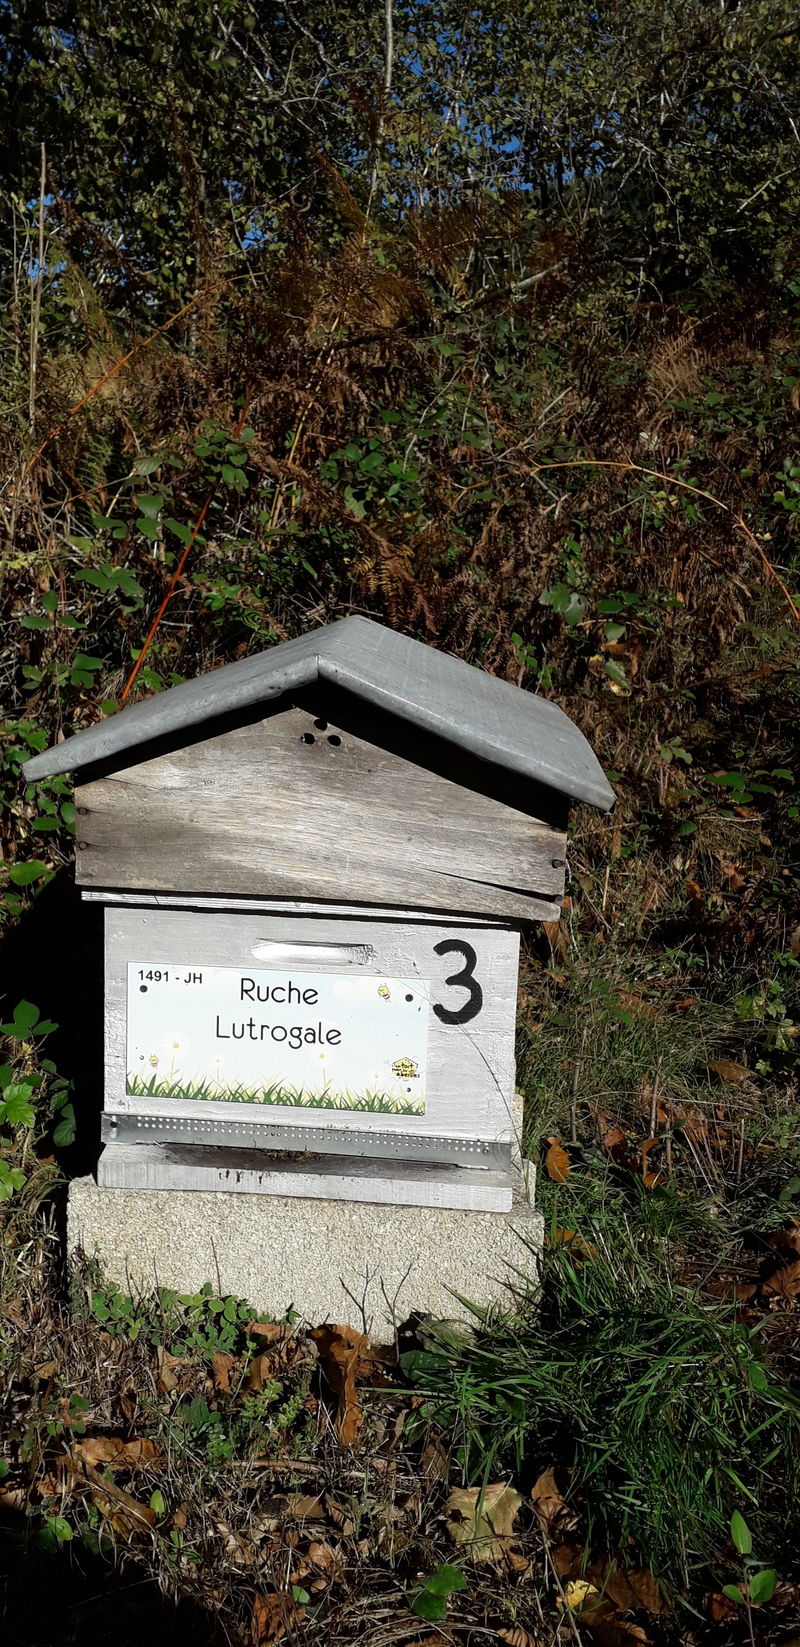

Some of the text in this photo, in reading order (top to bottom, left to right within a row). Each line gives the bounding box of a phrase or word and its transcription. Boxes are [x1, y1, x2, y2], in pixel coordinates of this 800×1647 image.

[137, 969, 169, 982] 1491
[183, 972, 203, 984] JH
[240, 977, 319, 1006] Ruche
[432, 938, 483, 1026] 3
[215, 1015, 342, 1050] Lutrogale
